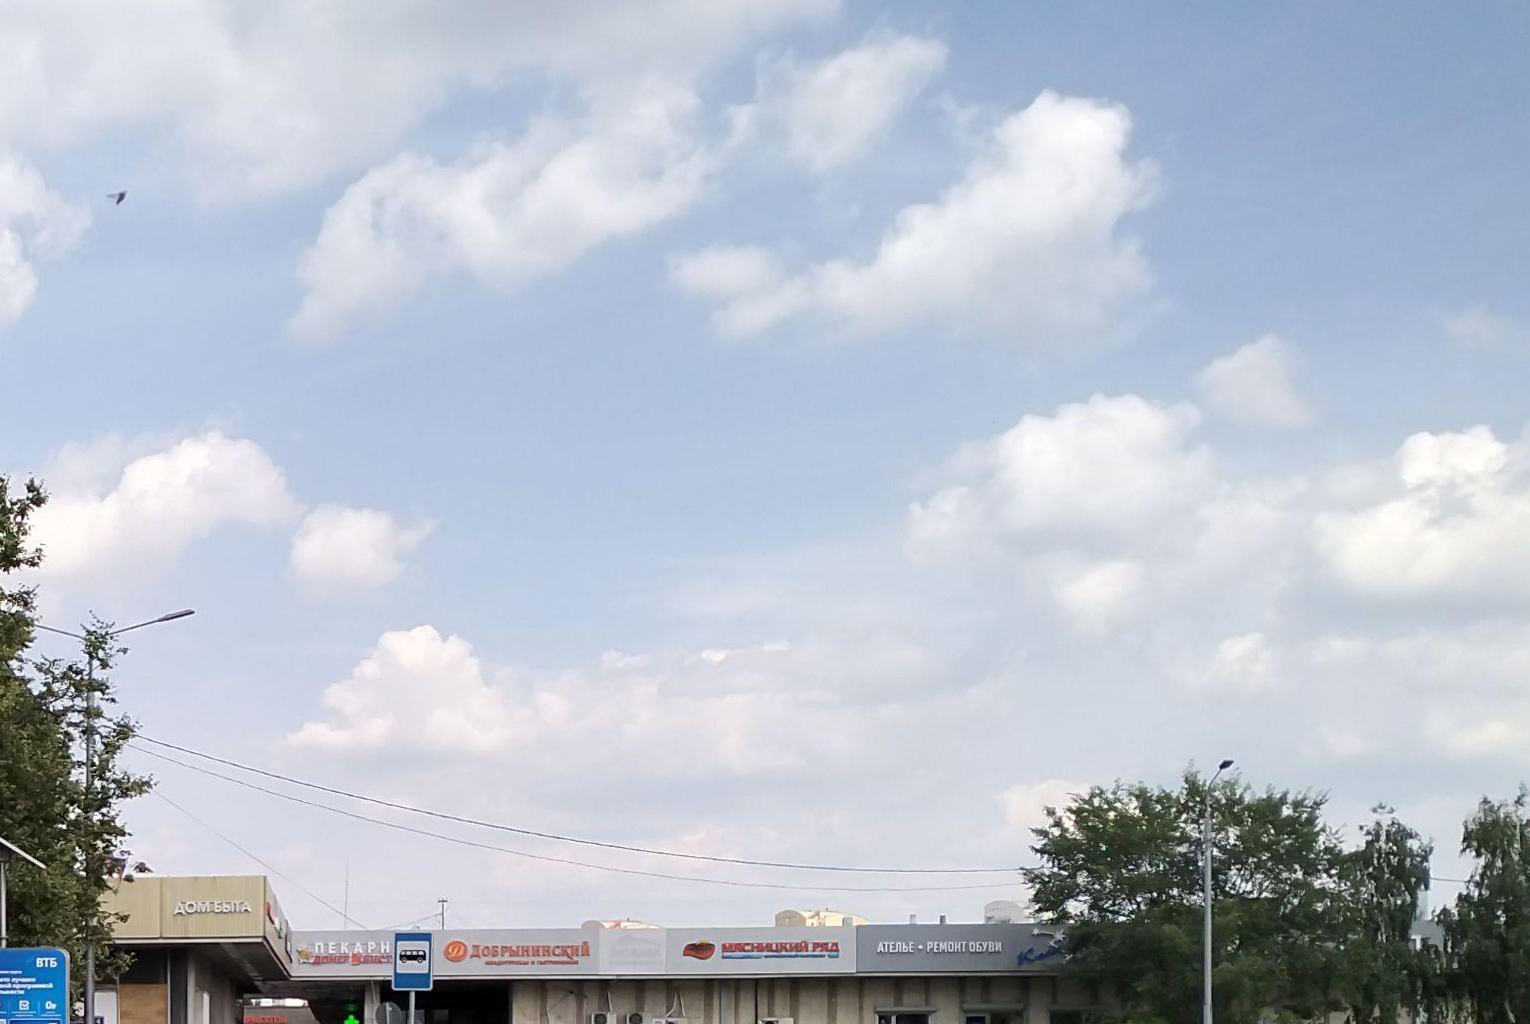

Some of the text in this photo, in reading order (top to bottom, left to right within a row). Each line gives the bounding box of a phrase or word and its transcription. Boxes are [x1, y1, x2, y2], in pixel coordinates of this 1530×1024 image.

[173, 901, 252, 915] ДОМ БЫТА
[315, 941, 390, 953] ПЕКАРН
[721, 940, 840, 953] МЯСНИЦКИЙ РЯД
[877, 941, 1002, 953] АТЕЛЬЕ РЕМОНТ ОБУВИ
[35, 957, 58, 968] ВТБ
